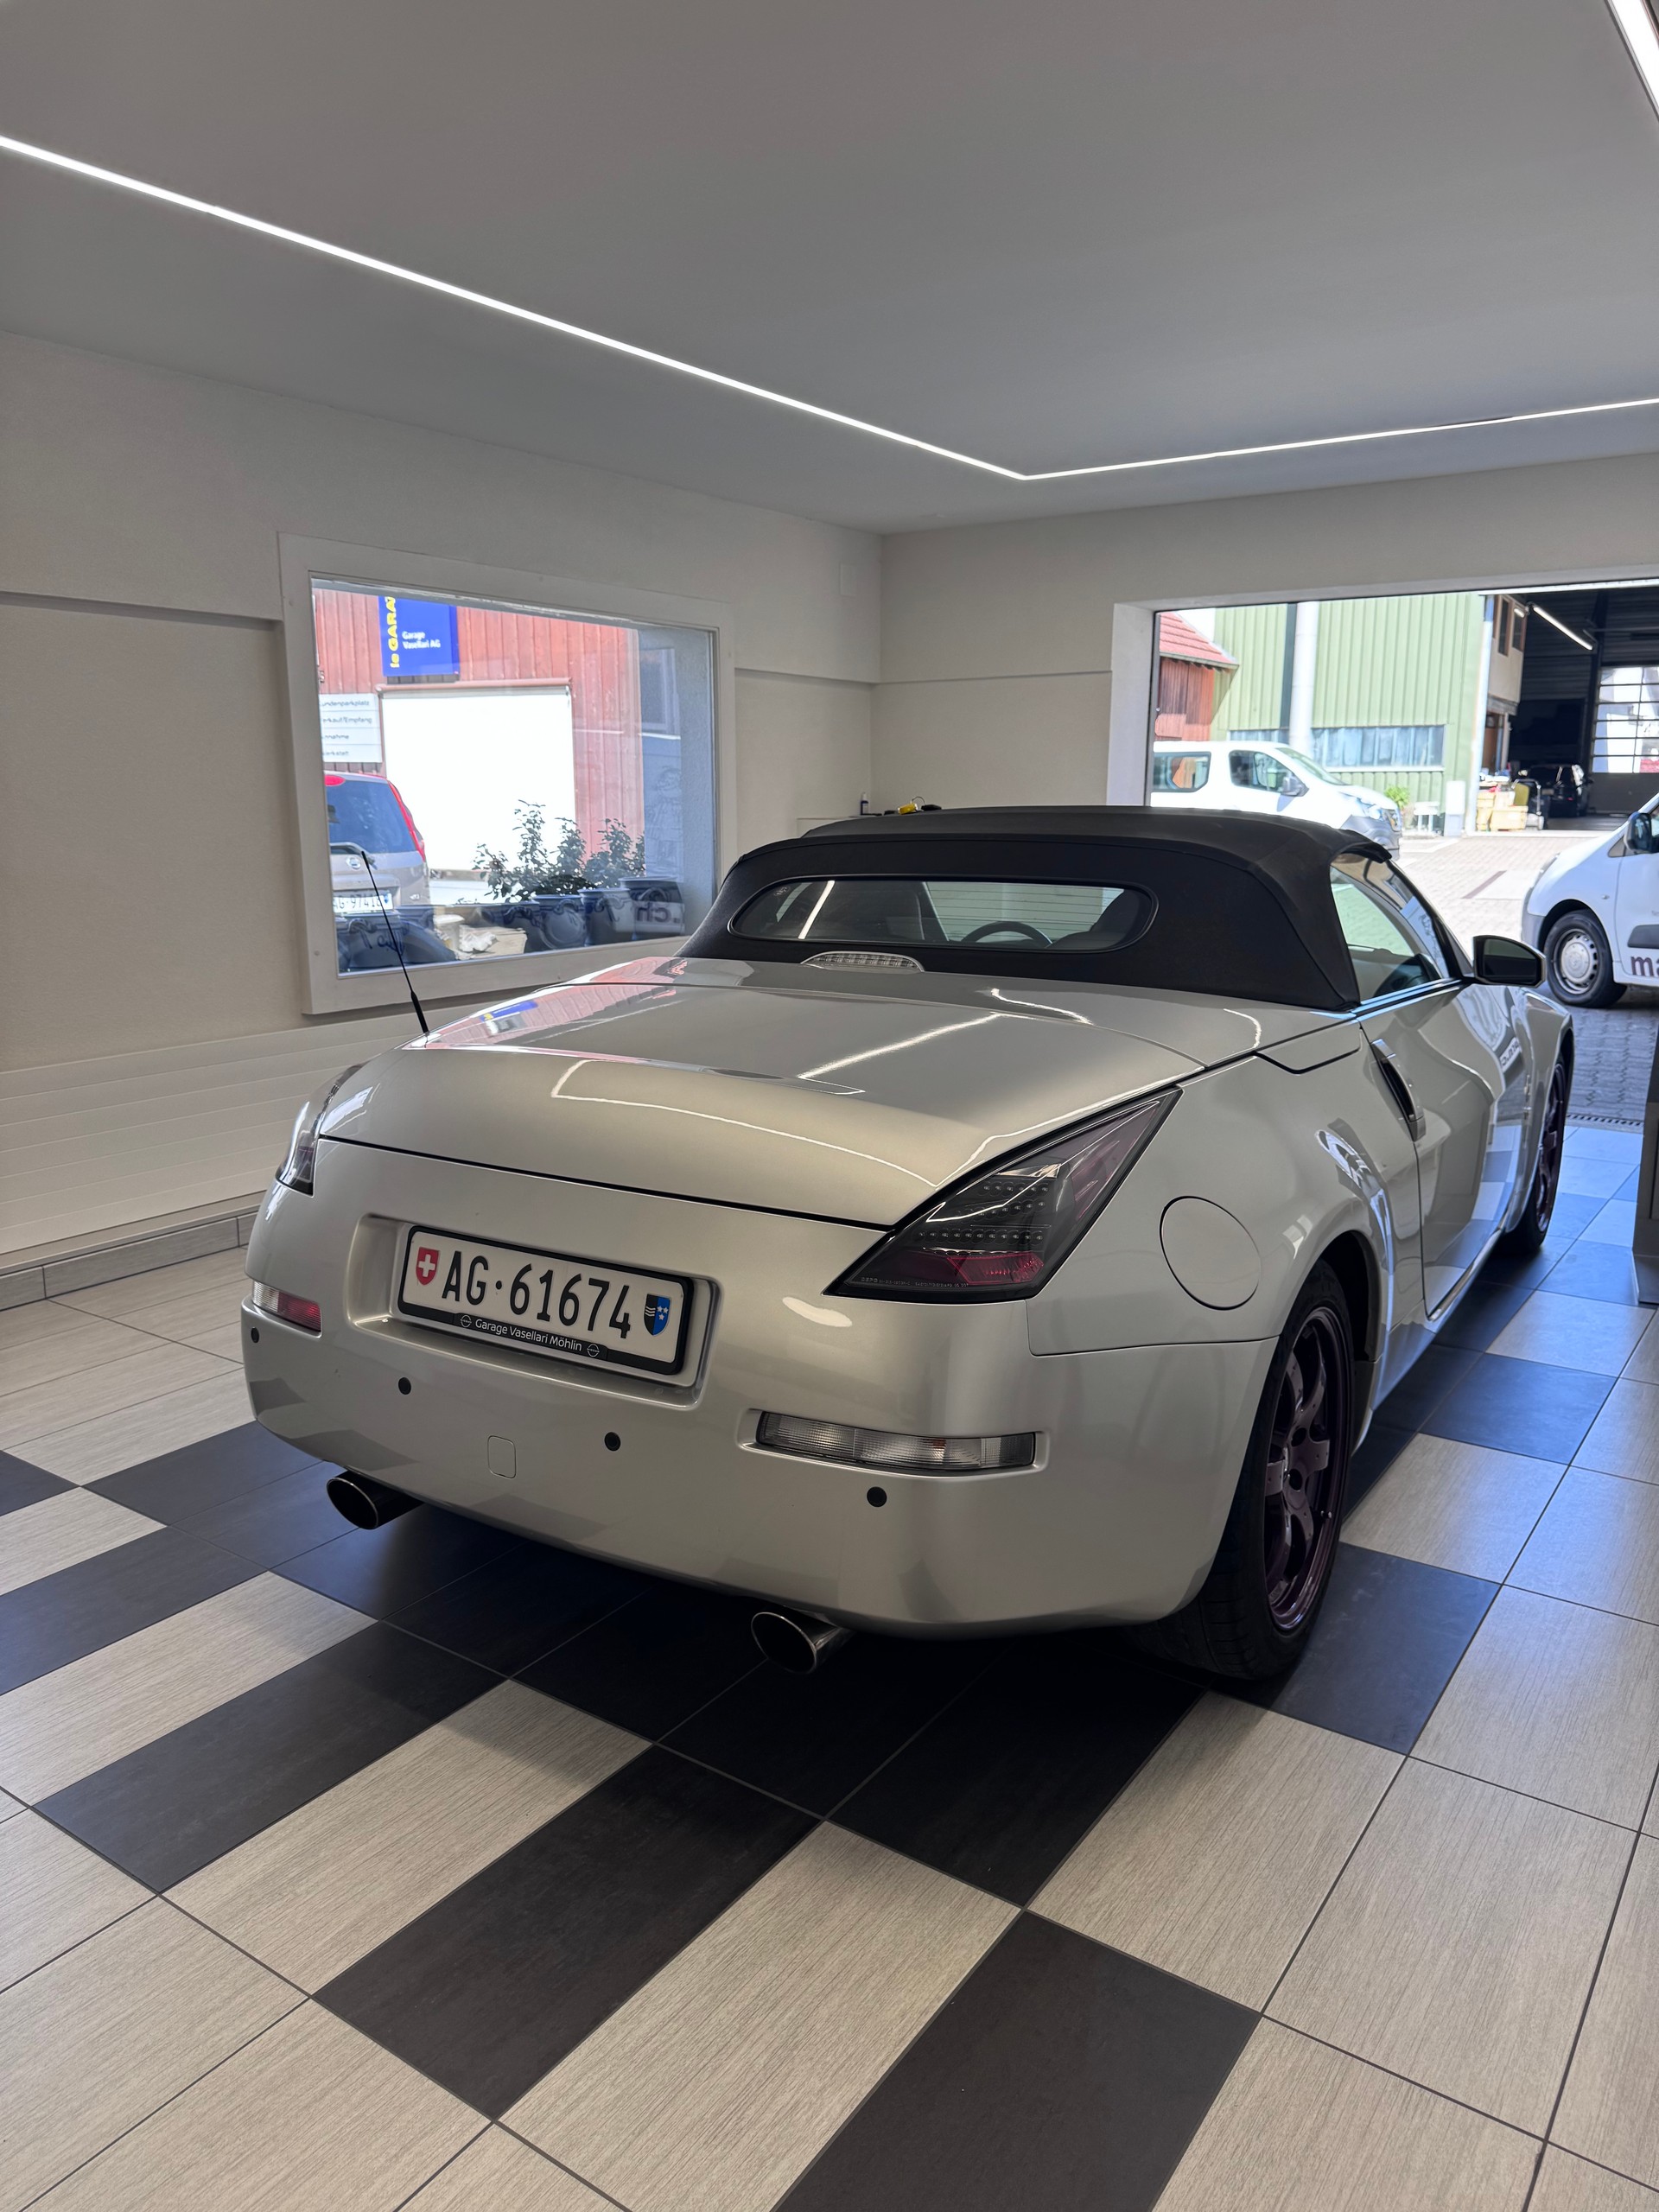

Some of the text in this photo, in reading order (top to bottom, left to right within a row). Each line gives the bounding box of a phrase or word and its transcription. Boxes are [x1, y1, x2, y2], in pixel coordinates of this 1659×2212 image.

[402, 631, 426, 641] Garage
[475, 1319, 582, 1351] Garage Vasellari Möhlin
